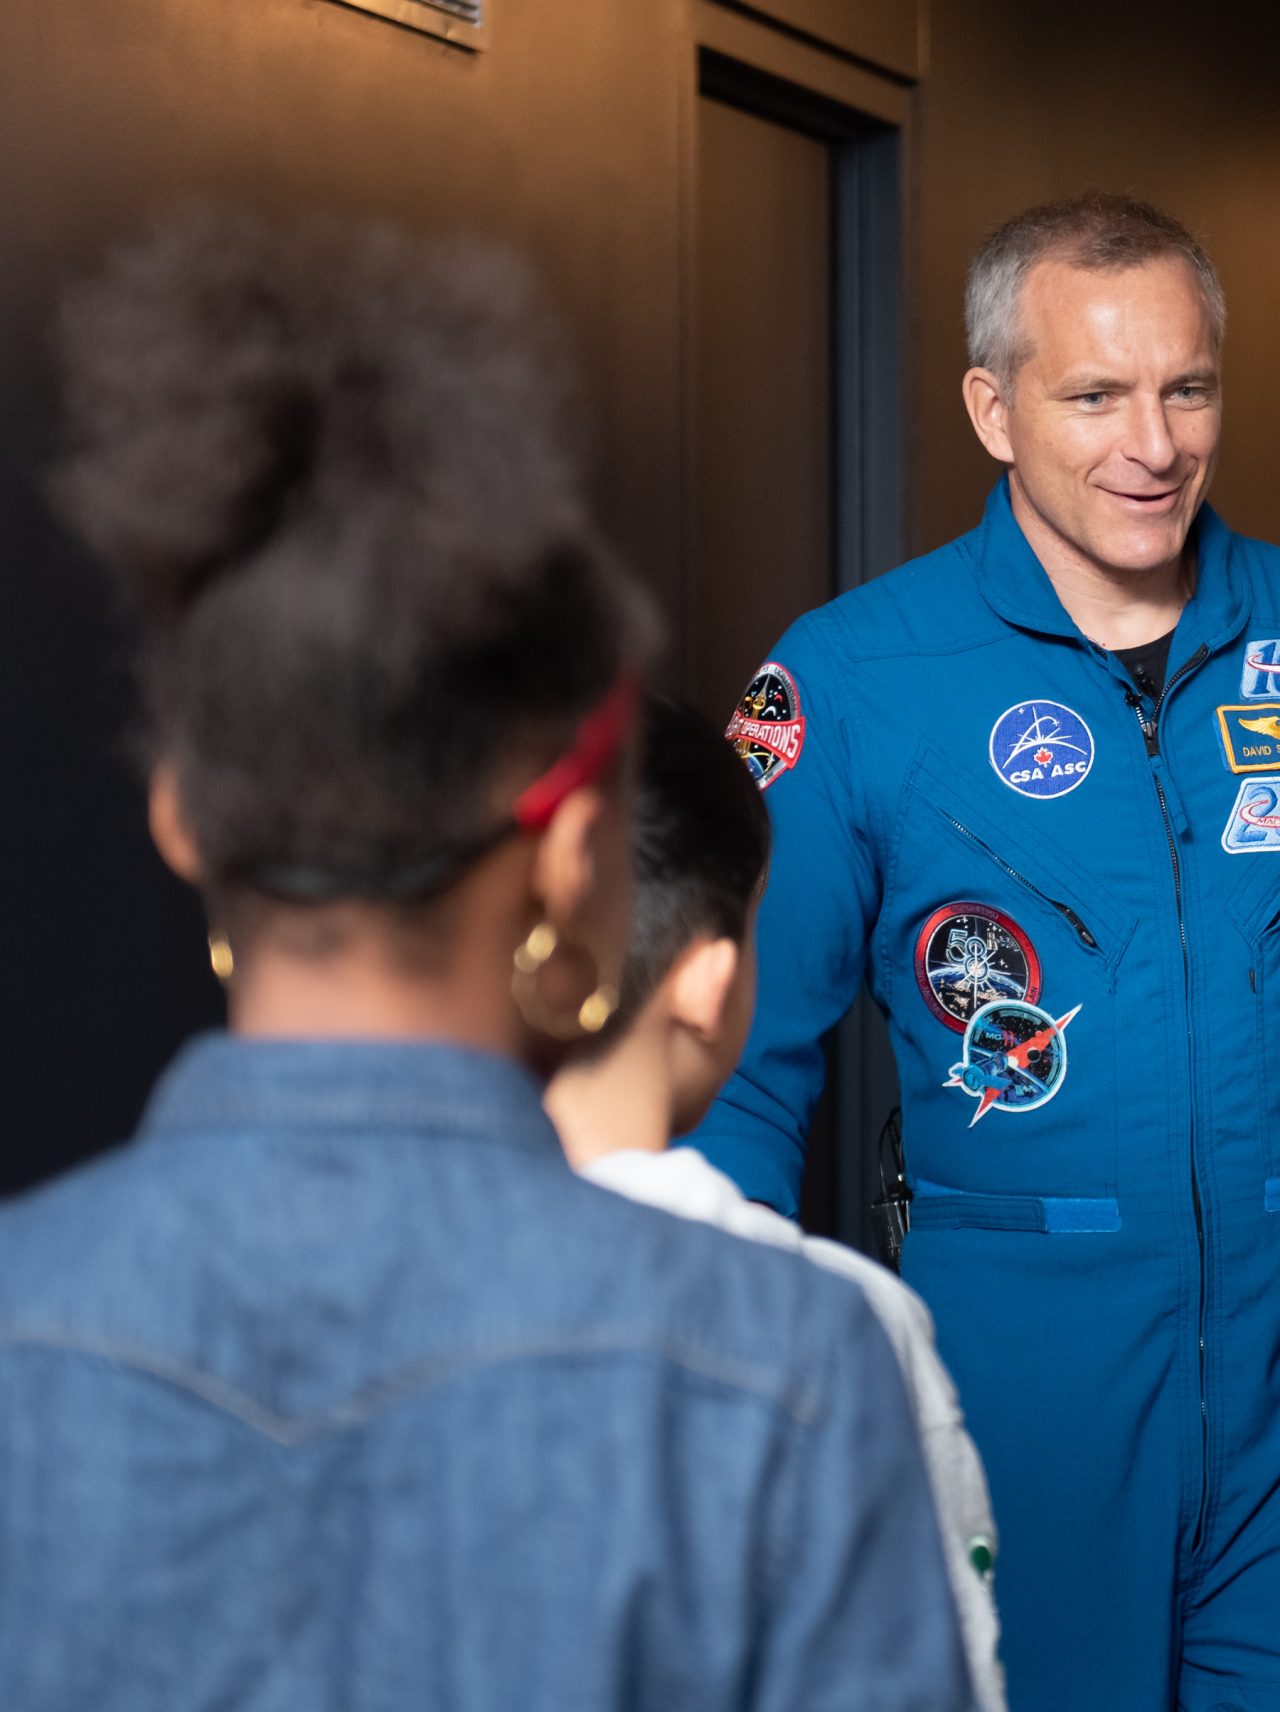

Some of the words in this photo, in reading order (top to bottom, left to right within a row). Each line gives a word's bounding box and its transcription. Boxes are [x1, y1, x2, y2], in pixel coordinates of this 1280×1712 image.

[741, 720, 801, 759] OPERATIONS
[1242, 745, 1272, 757] DAVID
[1009, 767, 1044, 784] CSA
[1050, 761, 1087, 778] ASC
[945, 928, 988, 982] 58
